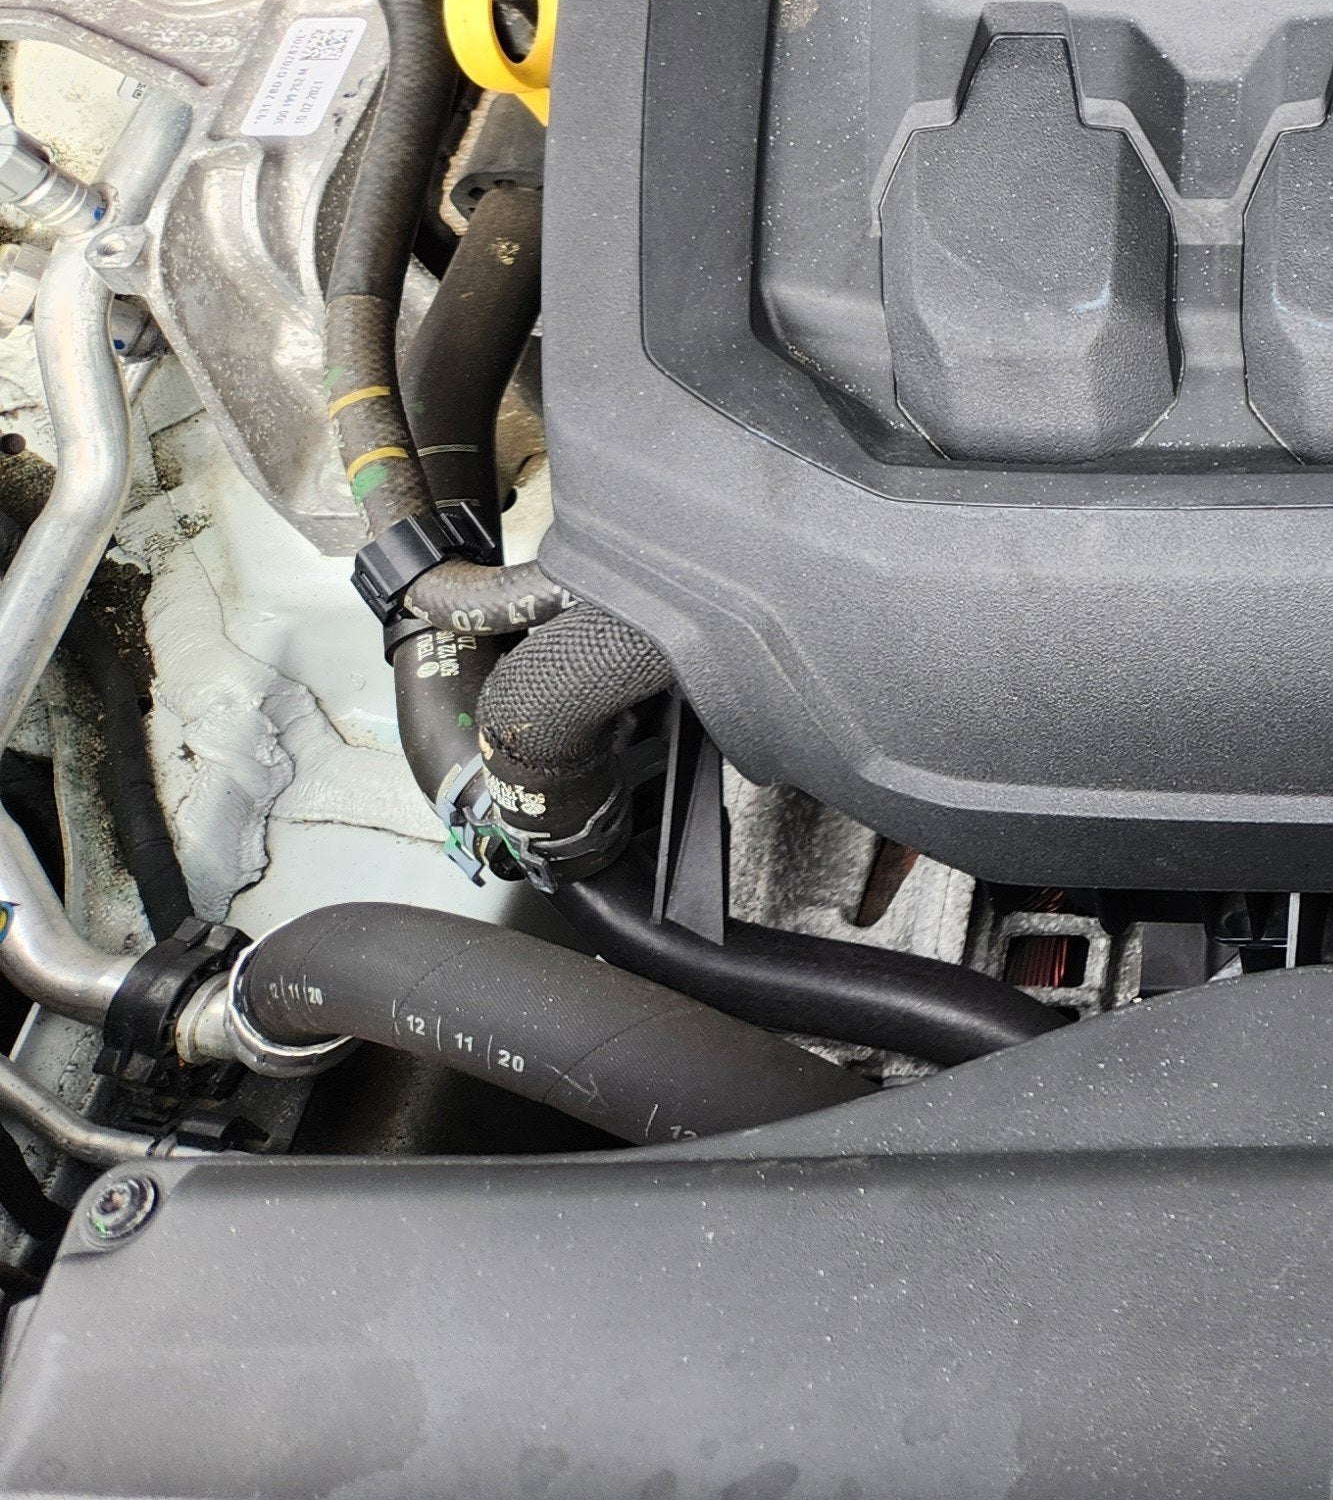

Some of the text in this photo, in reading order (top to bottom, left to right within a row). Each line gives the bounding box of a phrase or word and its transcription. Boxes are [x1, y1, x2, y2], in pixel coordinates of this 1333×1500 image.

[307, 986, 323, 1005] 20
[406, 1014, 525, 1074] 12 11 20
